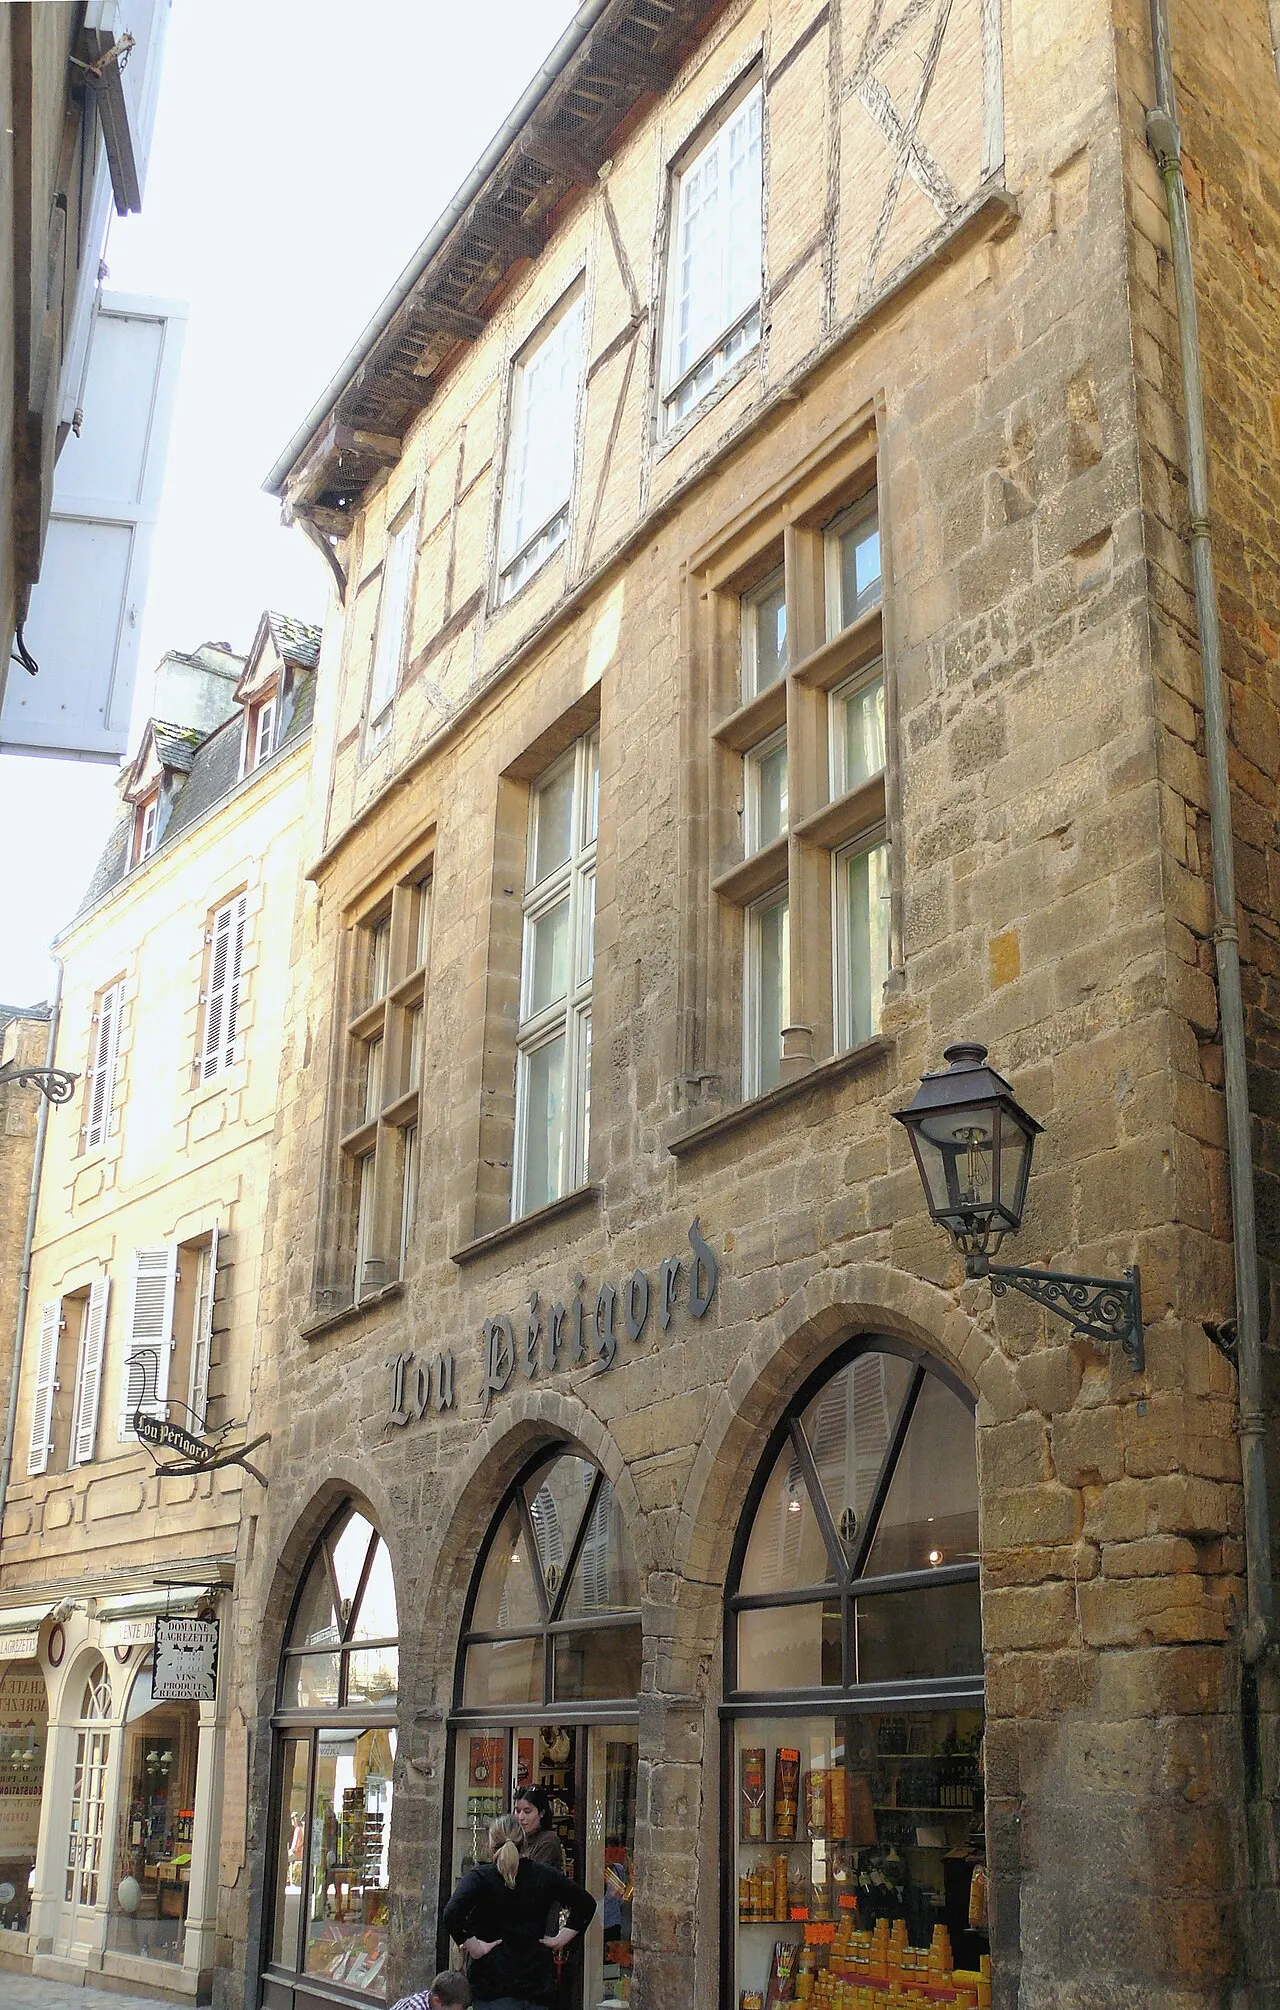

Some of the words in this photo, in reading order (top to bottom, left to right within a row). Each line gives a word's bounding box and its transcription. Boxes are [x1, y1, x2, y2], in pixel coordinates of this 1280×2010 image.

[385, 1349, 453, 1427] Lou
[137, 1415, 158, 1439] Lou
[123, 1623, 142, 1639] ENTE
[168, 1622, 209, 1633] DOMAINE
[160, 1632, 216, 1643] LAGREZETTE
[176, 1673, 197, 1681] VINS
[163, 1682, 207, 1690] PRODUITS
[159, 1690, 210, 1699] REGIONAUX
